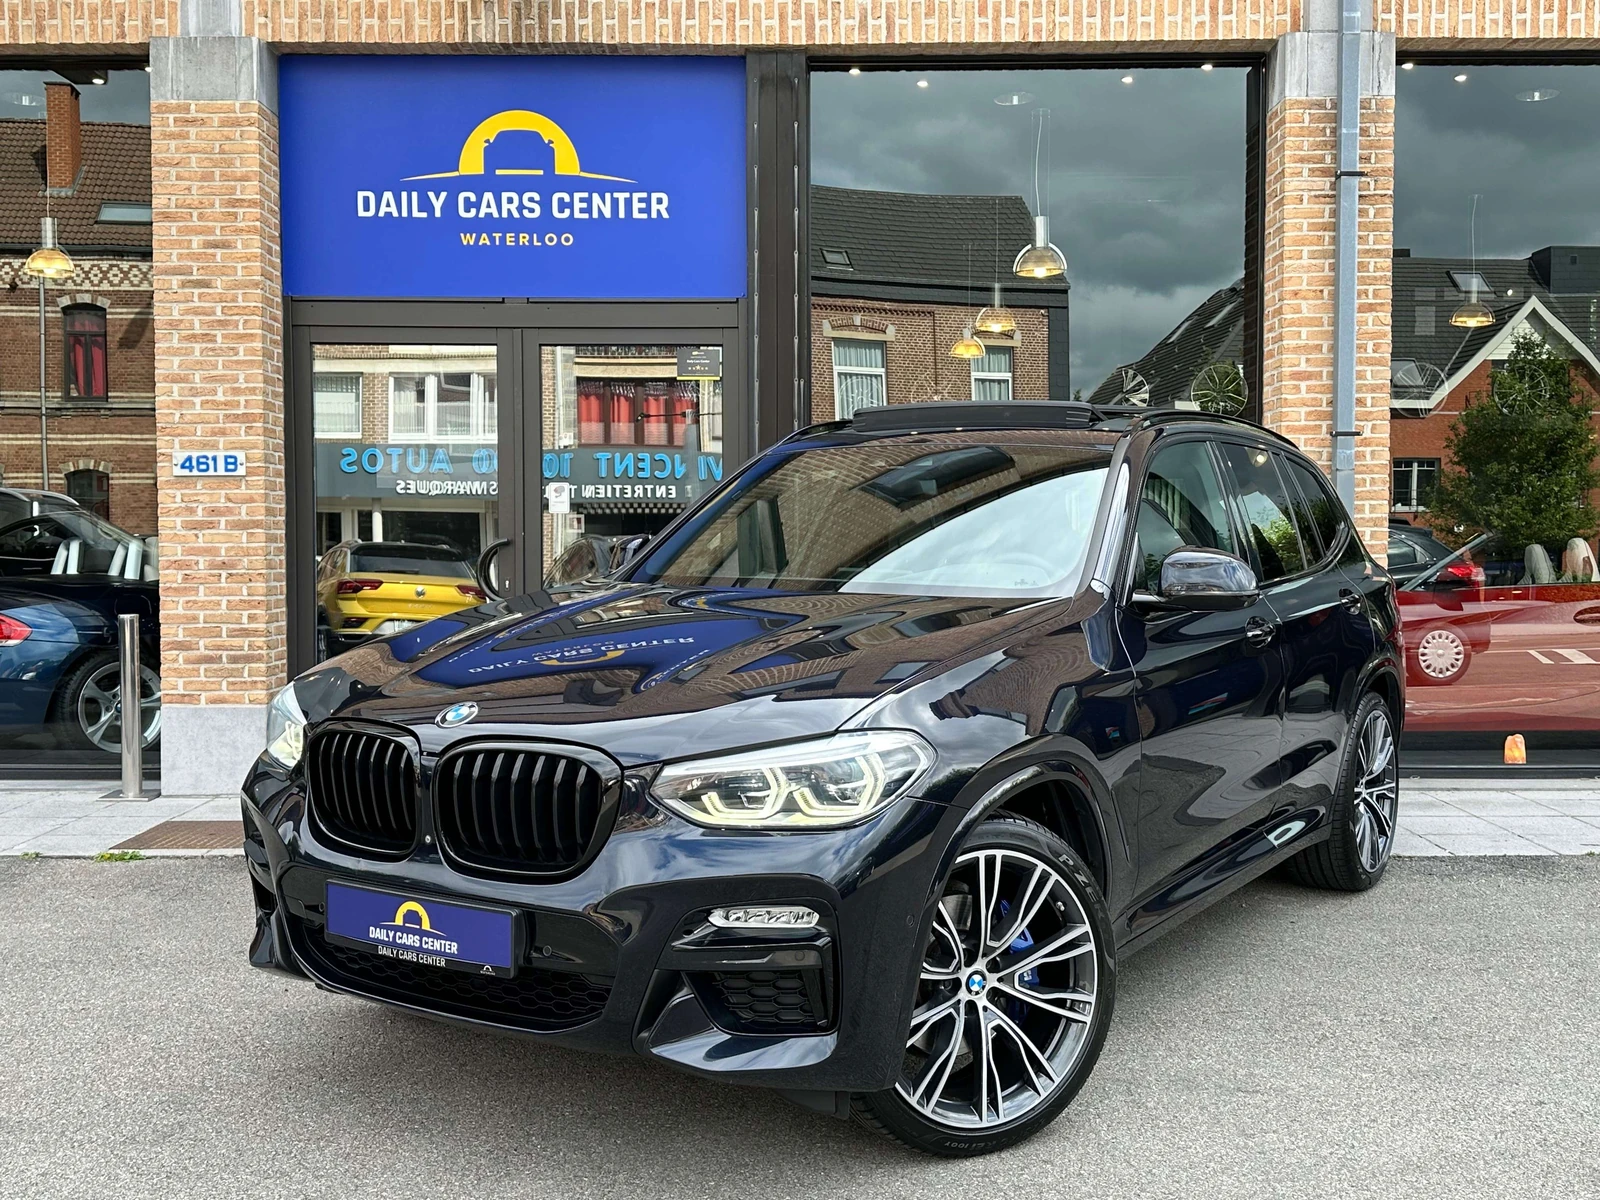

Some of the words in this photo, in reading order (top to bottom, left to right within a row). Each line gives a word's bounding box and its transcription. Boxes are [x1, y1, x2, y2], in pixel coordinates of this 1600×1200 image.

[357, 190, 448, 218] DAILY
[457, 191, 541, 219] CARS
[551, 191, 670, 219] CENTER
[460, 232, 575, 246] WATERLOO
[180, 454, 218, 473] 461
[223, 454, 239, 473] B
[369, 926, 395, 942] DAILY
[395, 931, 420, 947] CARS
[421, 936, 458, 955] CENTER
[377, 945, 398, 958] DAILY
[398, 950, 418, 962] CARS
[418, 954, 446, 968] CENTER
